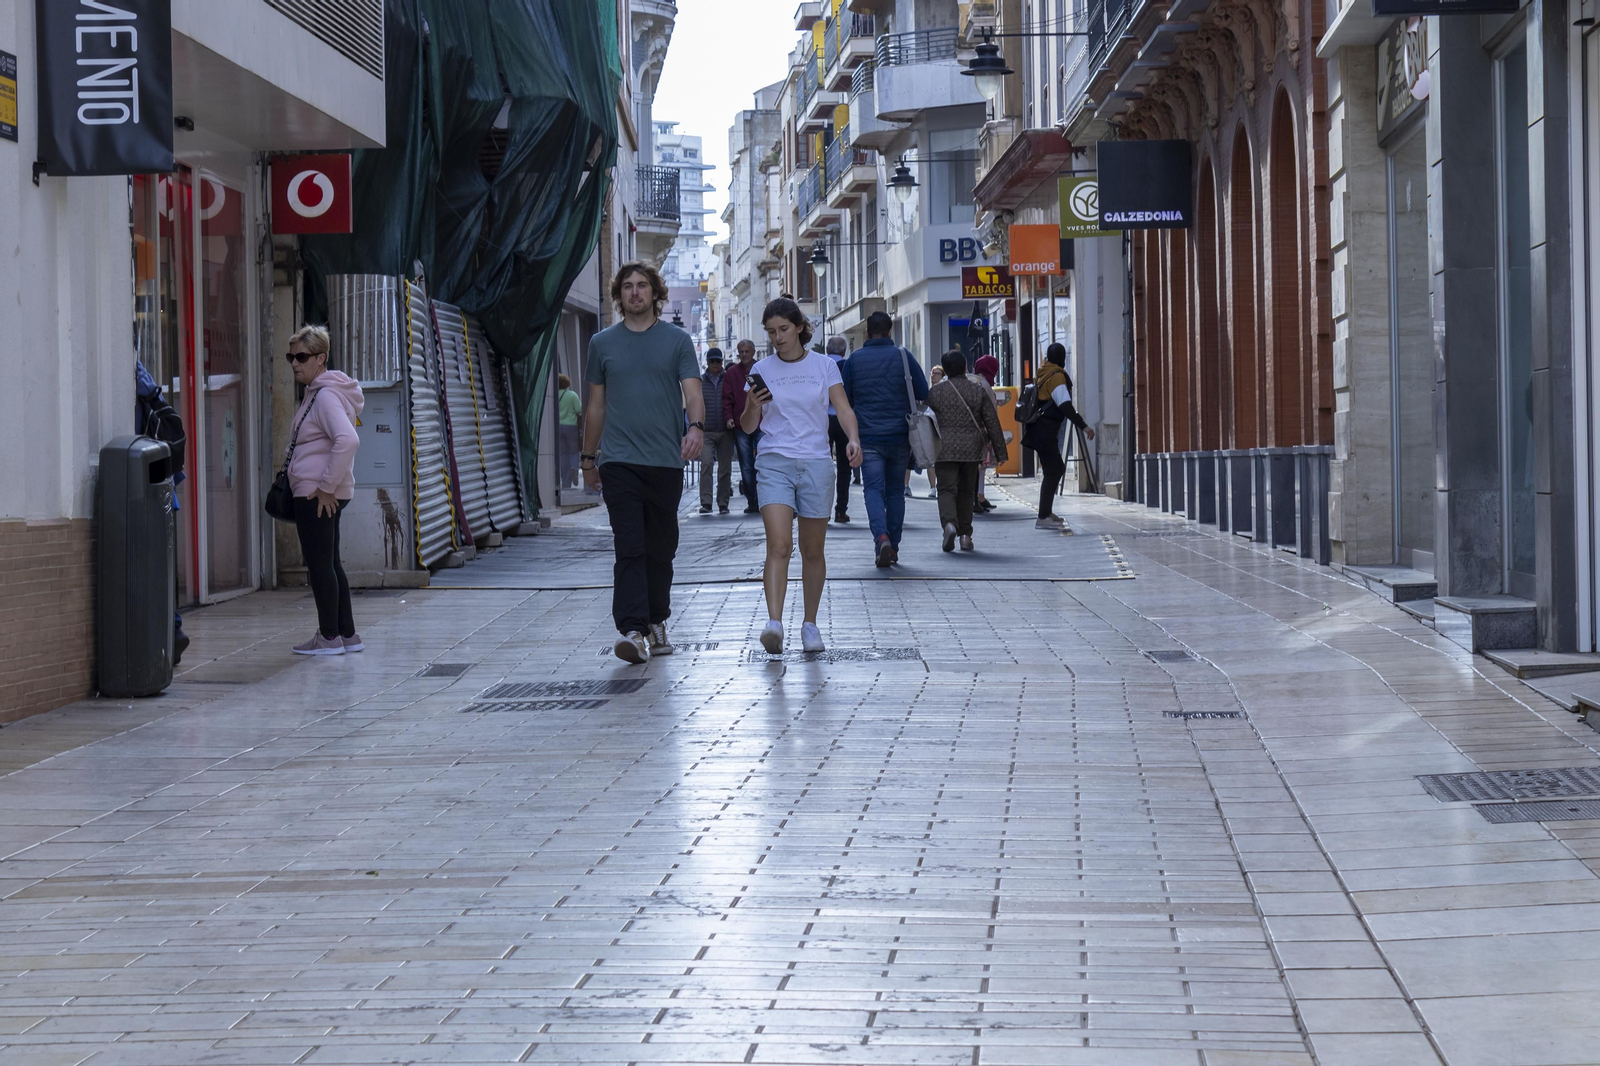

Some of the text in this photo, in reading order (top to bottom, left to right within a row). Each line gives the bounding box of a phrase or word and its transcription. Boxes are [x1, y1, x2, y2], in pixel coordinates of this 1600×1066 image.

[1104, 210, 1183, 224] CALZEDONIA
[1012, 261, 1056, 273] orange
[965, 284, 1012, 294] TABACOS
